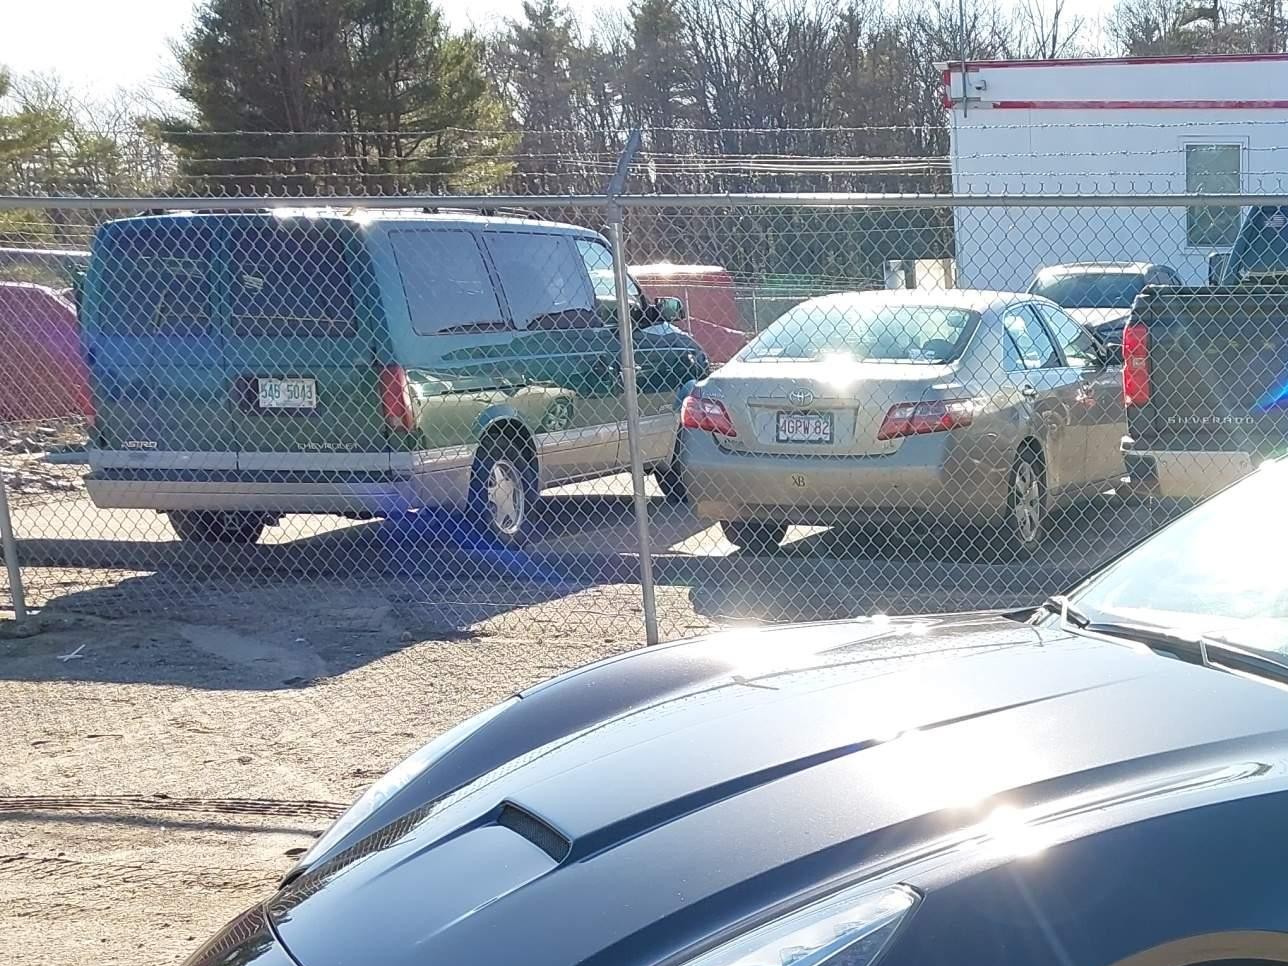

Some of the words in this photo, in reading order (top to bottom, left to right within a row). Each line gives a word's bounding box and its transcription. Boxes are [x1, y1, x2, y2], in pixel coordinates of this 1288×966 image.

[1168, 416, 1254, 424] SILVERADO
[780, 420, 810, 434] 4GPW
[815, 420, 830, 435] 82
[120, 440, 158, 448] ASTRO
